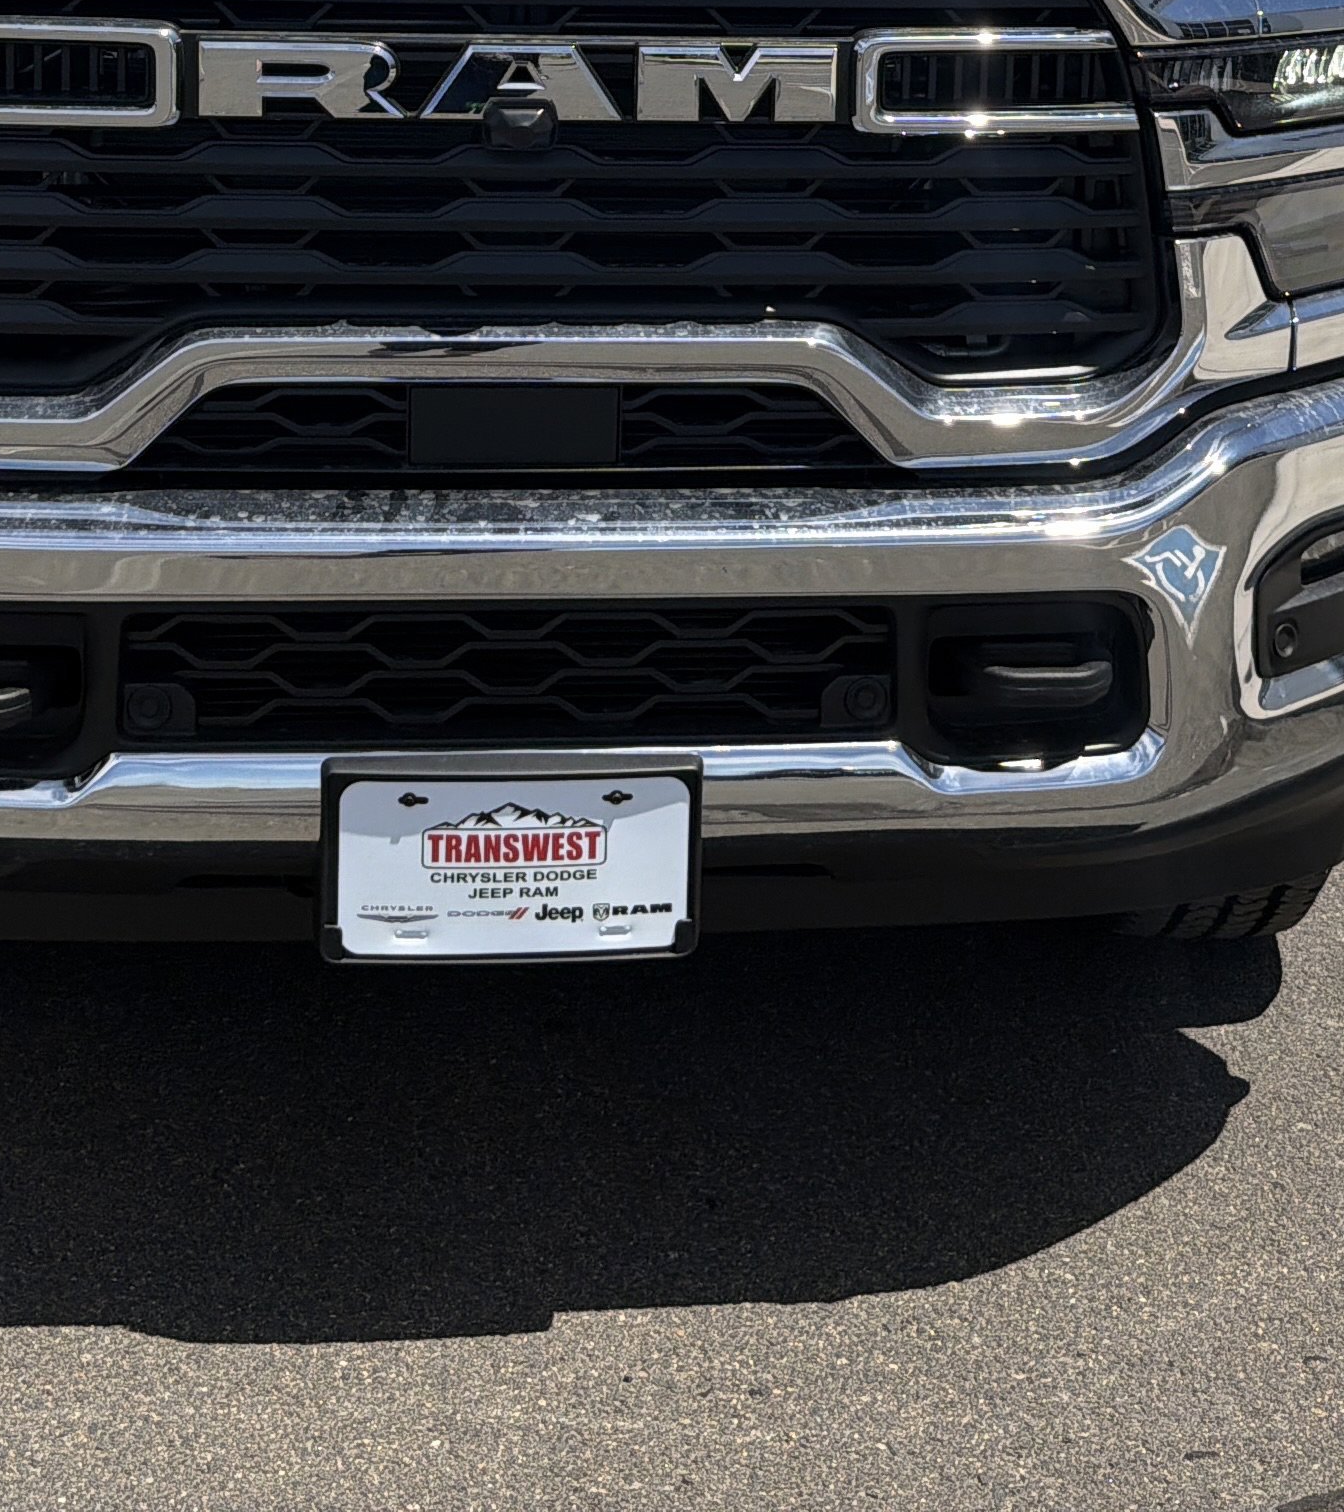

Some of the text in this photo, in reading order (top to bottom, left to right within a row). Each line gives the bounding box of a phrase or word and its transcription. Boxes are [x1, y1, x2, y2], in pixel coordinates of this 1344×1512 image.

[198, 39, 838, 122] RAM
[427, 831, 601, 863] TRANSWEST
[430, 868, 598, 884] CHRYSLER DODGE
[468, 885, 559, 900] JEEP RAM
[361, 904, 434, 912] CHRYSLER
[535, 903, 584, 922] Jeep
[612, 902, 673, 915] RAM
